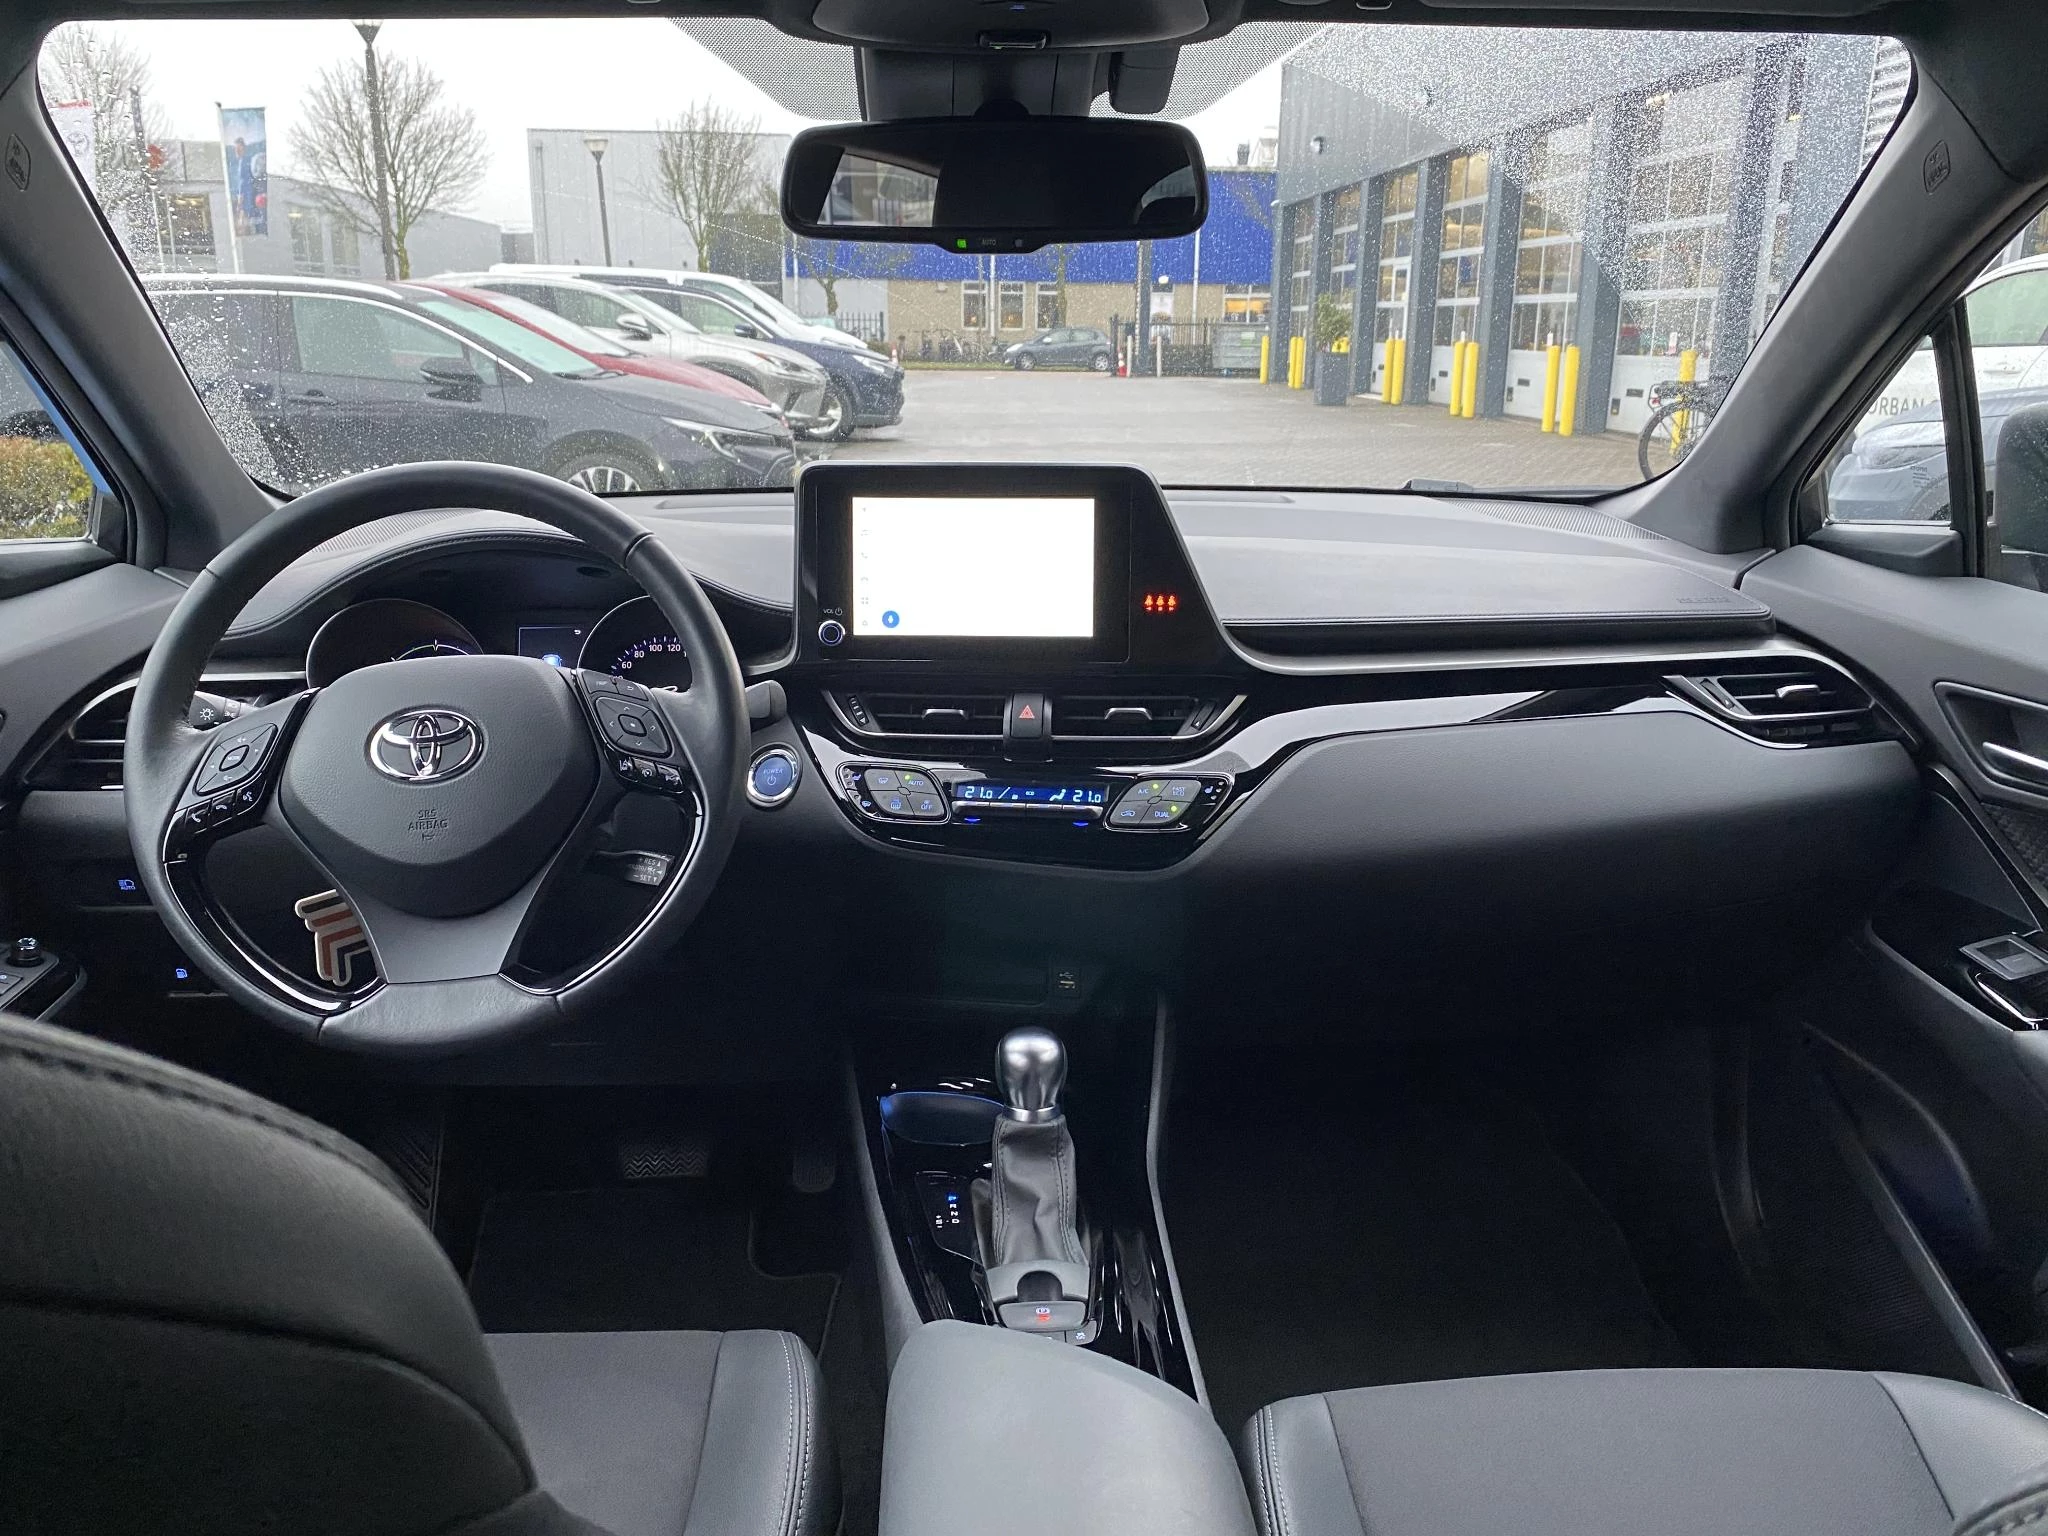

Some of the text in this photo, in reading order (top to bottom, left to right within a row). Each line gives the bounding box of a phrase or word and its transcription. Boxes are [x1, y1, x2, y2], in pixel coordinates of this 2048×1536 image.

[648, 644, 663, 652] 100
[667, 644, 681, 652] 120
[634, 650, 645, 658] 80
[621, 661, 632, 669] 60
[762, 767, 783, 775] POWER
[418, 809, 437, 819] SRS
[1154, 810, 1170, 818] DUAL
[407, 819, 448, 831] AIRBAG
